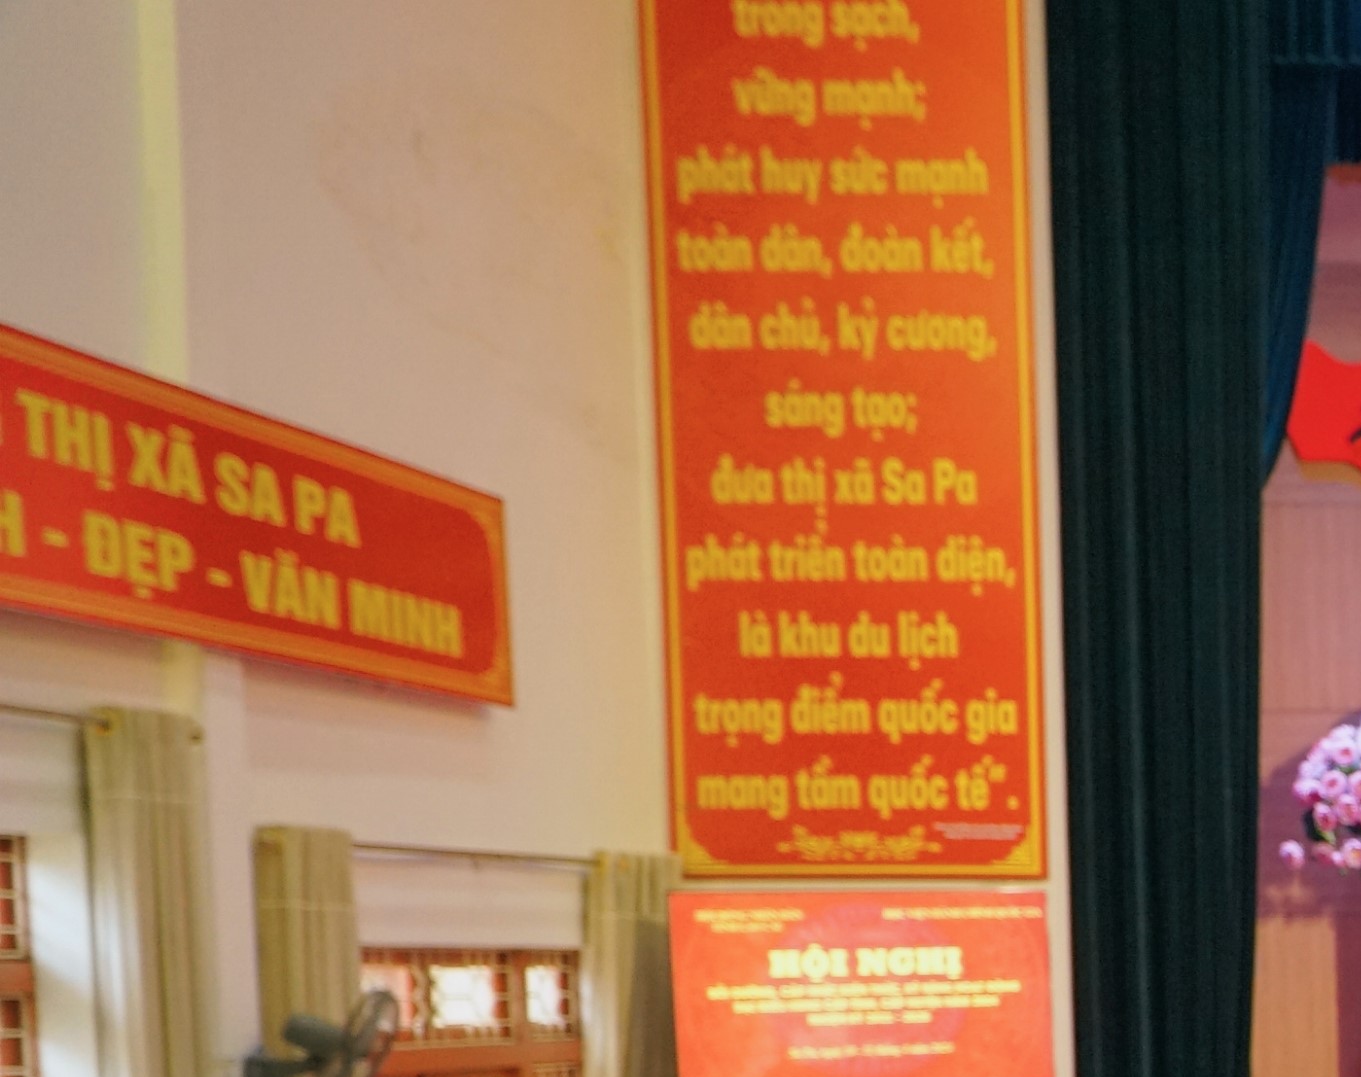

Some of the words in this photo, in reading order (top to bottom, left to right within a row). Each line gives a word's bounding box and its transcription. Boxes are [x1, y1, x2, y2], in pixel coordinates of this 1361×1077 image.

[732, 66, 816, 126] vững
[675, 144, 754, 204] phát
[760, 146, 822, 204] huy
[829, 146, 888, 194] sức
[895, 147, 989, 208] mạnh
[676, 222, 752, 271] toàn
[760, 224, 832, 278] dân,
[840, 222, 923, 272] đoàn
[931, 216, 993, 277] kết,
[690, 301, 752, 350] dân
[760, 297, 830, 356] chủ,
[838, 297, 878, 360] kỷ
[887, 310, 997, 361] cương,
[764, 378, 845, 438] sáng
[851, 386, 917, 441] tạo;
[16, 387, 115, 491] THỊ
[126, 424, 206, 505] XÃ
[213, 452, 286, 528] SA
[292, 474, 362, 549] PA
[711, 454, 774, 503] đưa
[781, 456, 827, 516] thị
[835, 457, 874, 503] xã
[882, 459, 926, 504] Sa
[933, 459, 977, 503] Pa
[82, 509, 195, 600] ĐẸP
[239, 548, 341, 631] VĂN
[348, 577, 465, 660] MINH
[686, 532, 762, 591] phát
[769, 519, 846, 582] triển
[853, 534, 928, 582] toàn
[936, 535, 1015, 597] diện,
[738, 610, 772, 658] là
[778, 610, 841, 658] khu
[849, 610, 891, 658] du
[898, 610, 959, 670] lịch
[694, 694, 783, 748] trọng
[790, 671, 871, 734] điểm
[878, 678, 959, 743] quốc
[966, 688, 1018, 744] gia
[697, 775, 790, 820] mang
[795, 755, 861, 810] tầm
[868, 754, 949, 820] quốc
[768, 943, 848, 983] HỘI
